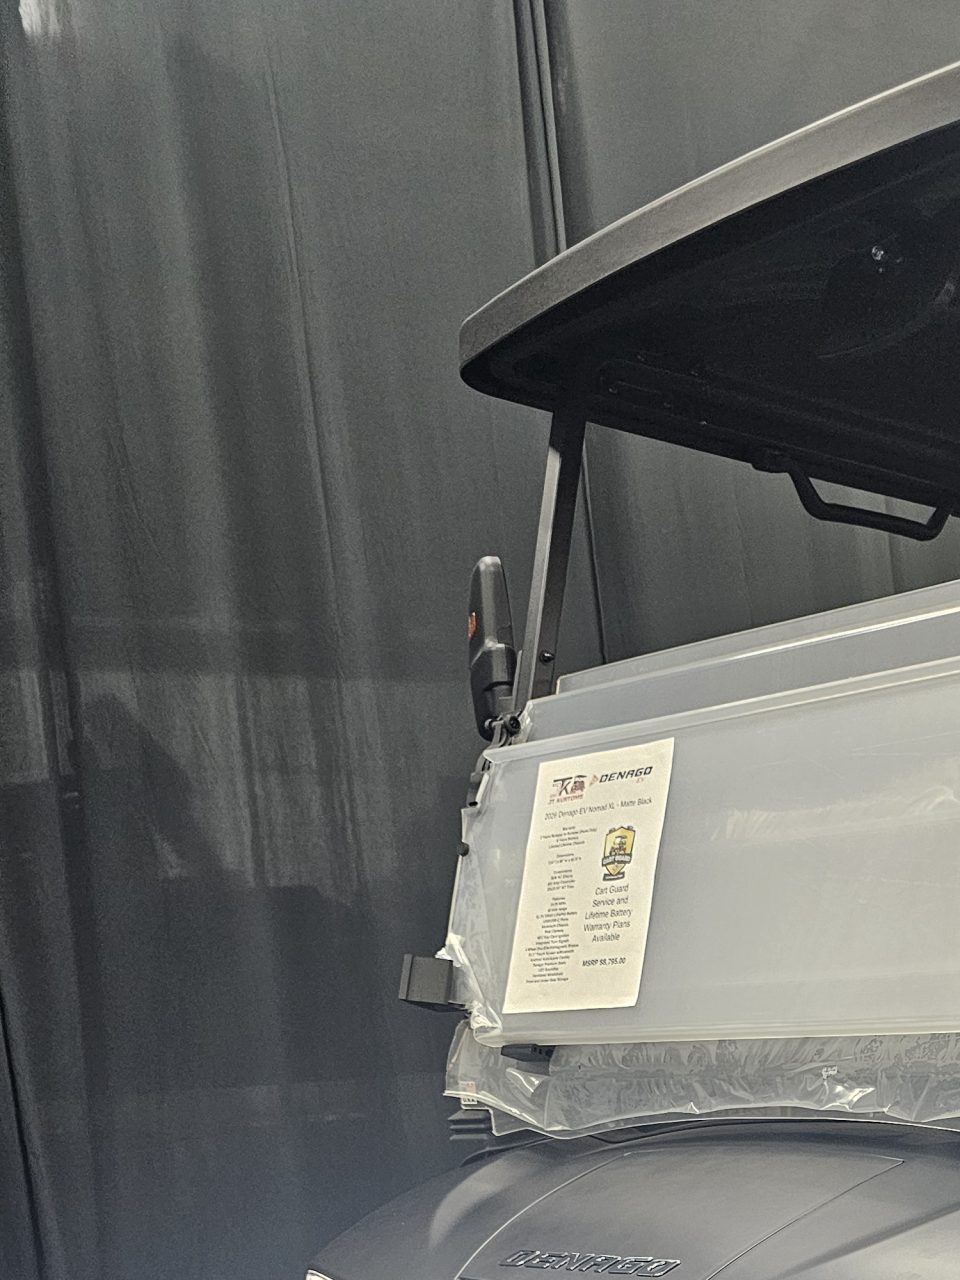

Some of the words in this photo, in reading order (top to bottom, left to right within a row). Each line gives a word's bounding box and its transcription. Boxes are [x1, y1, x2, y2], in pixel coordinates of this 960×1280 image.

[599, 766, 653, 783] DENAGO
[637, 797, 652, 806] Black
[595, 887, 608, 896] Cart
[609, 883, 629, 894] Guard
[592, 899, 615, 908] Service
[616, 896, 629, 905] and
[584, 911, 609, 920] Lifetime
[610, 909, 632, 918] Battery
[583, 922, 611, 932] Warranty
[612, 920, 631, 929] Plans
[592, 932, 620, 943] Available
[498, 1249, 682, 1277] DENAGO
